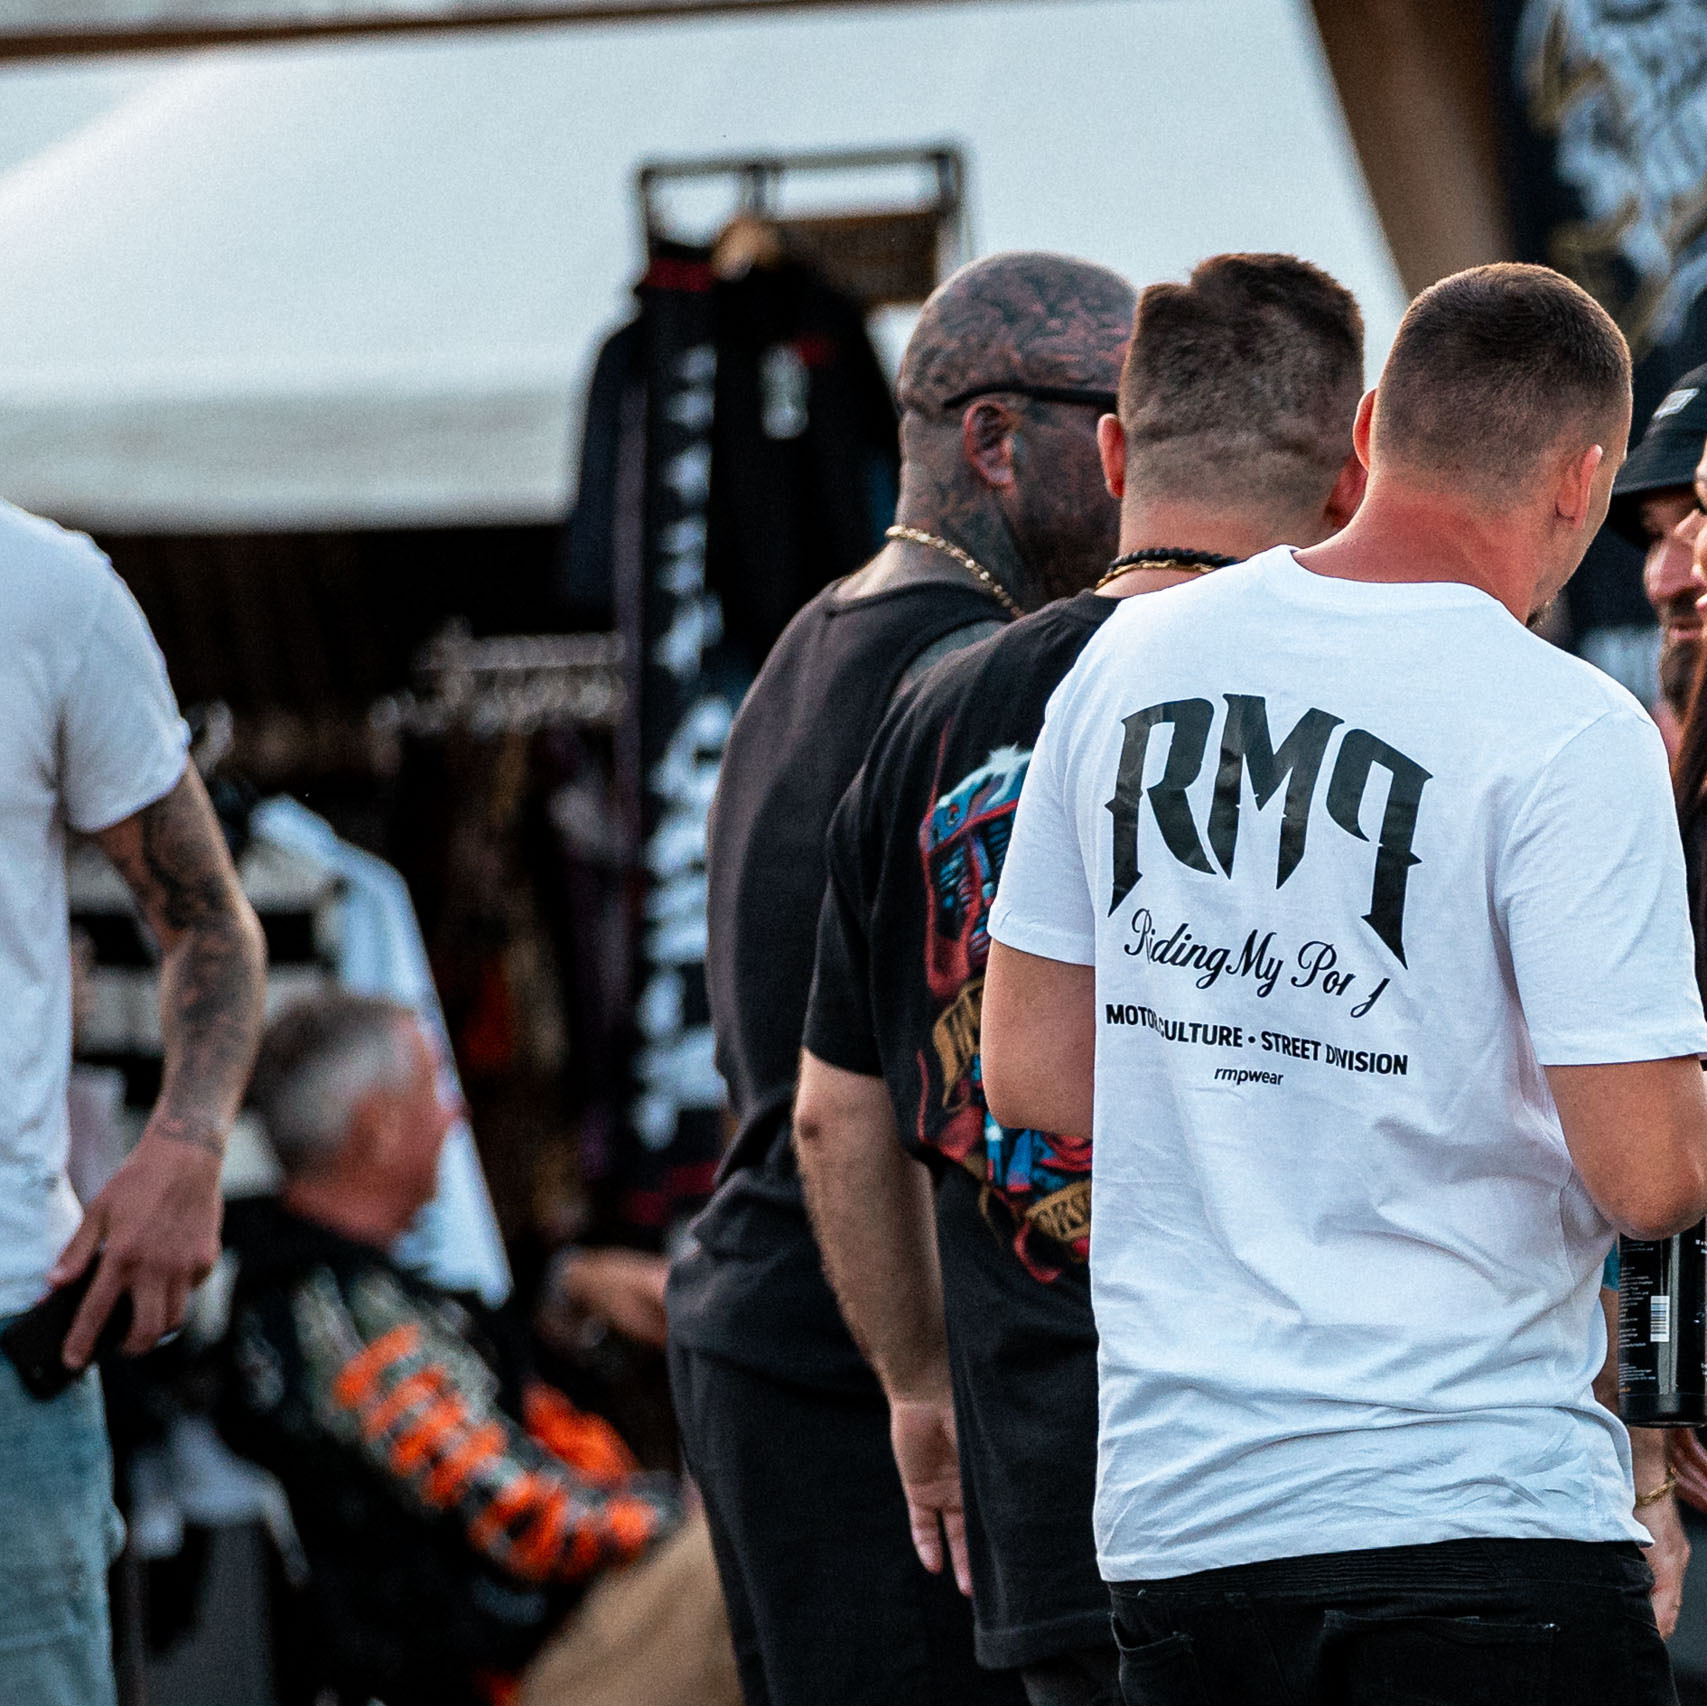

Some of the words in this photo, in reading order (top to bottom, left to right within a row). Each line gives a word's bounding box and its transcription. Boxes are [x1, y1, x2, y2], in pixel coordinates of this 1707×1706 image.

[1225, 929, 1284, 998] My
[1261, 1031, 1321, 1061] STREET
[1325, 1043, 1409, 1076] DIVISION
[1214, 1066, 1285, 1087] rmpwear
